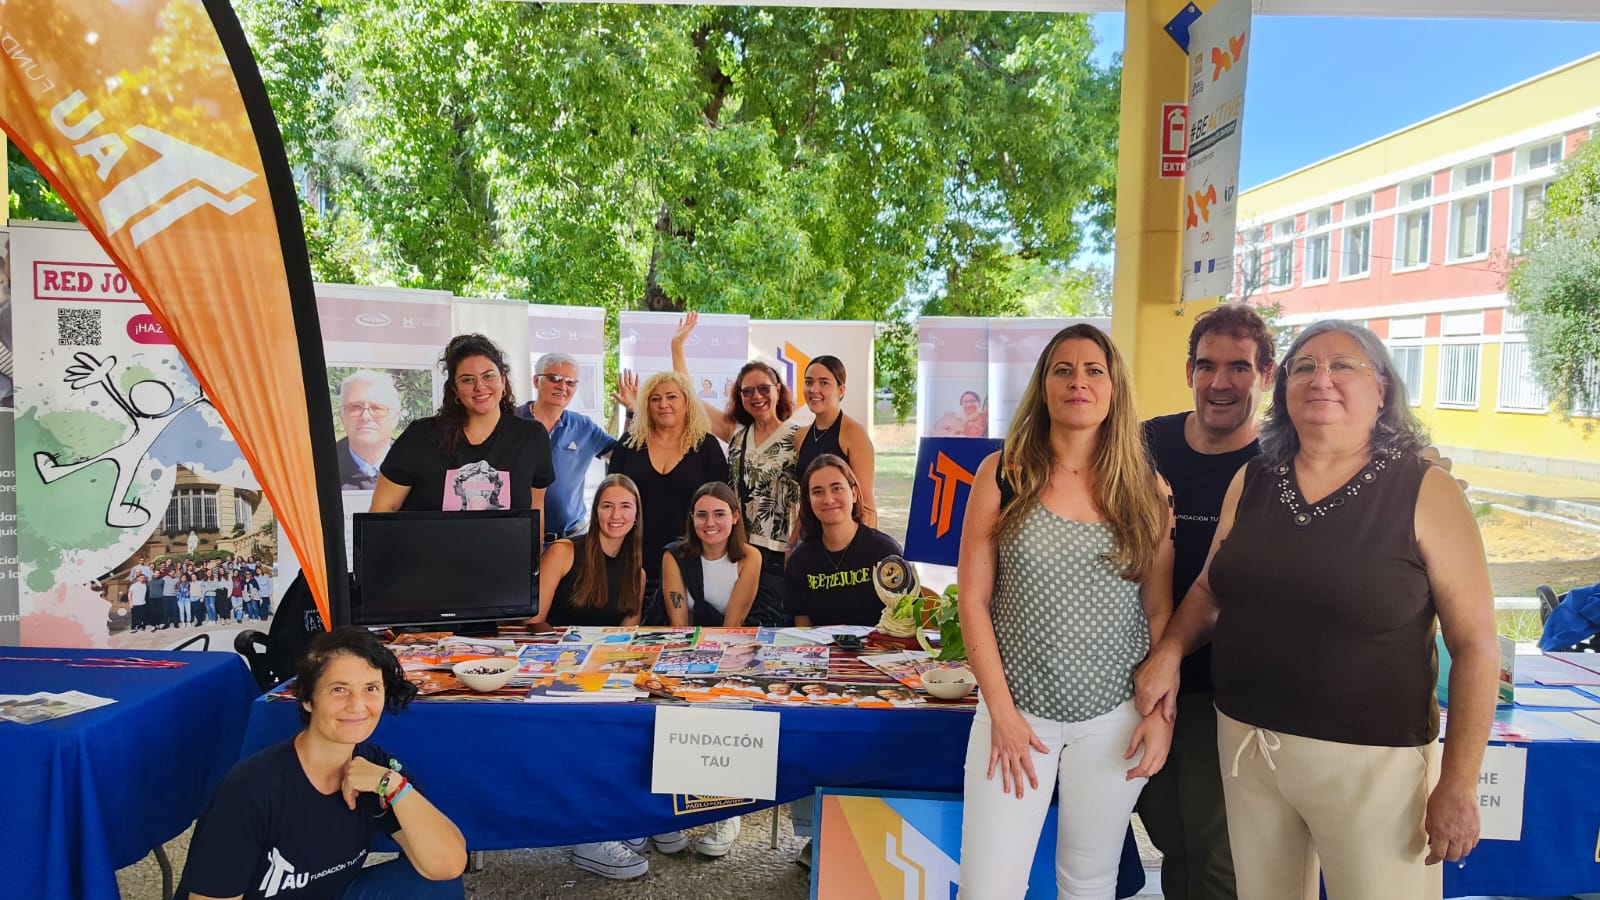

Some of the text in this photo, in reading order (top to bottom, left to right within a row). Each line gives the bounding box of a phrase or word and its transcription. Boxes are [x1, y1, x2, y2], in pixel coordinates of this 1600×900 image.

[43, 269, 137, 295] RED JO
[807, 567, 871, 590] BEETLEJUICE
[668, 733, 764, 749] FUNDACIÓN
[700, 755, 730, 768] TAU
[1477, 772, 1499, 785] HE
[1476, 795, 1501, 808] EN
[259, 847, 310, 897] TAU
[310, 863, 346, 881] FUNDACIÓN
